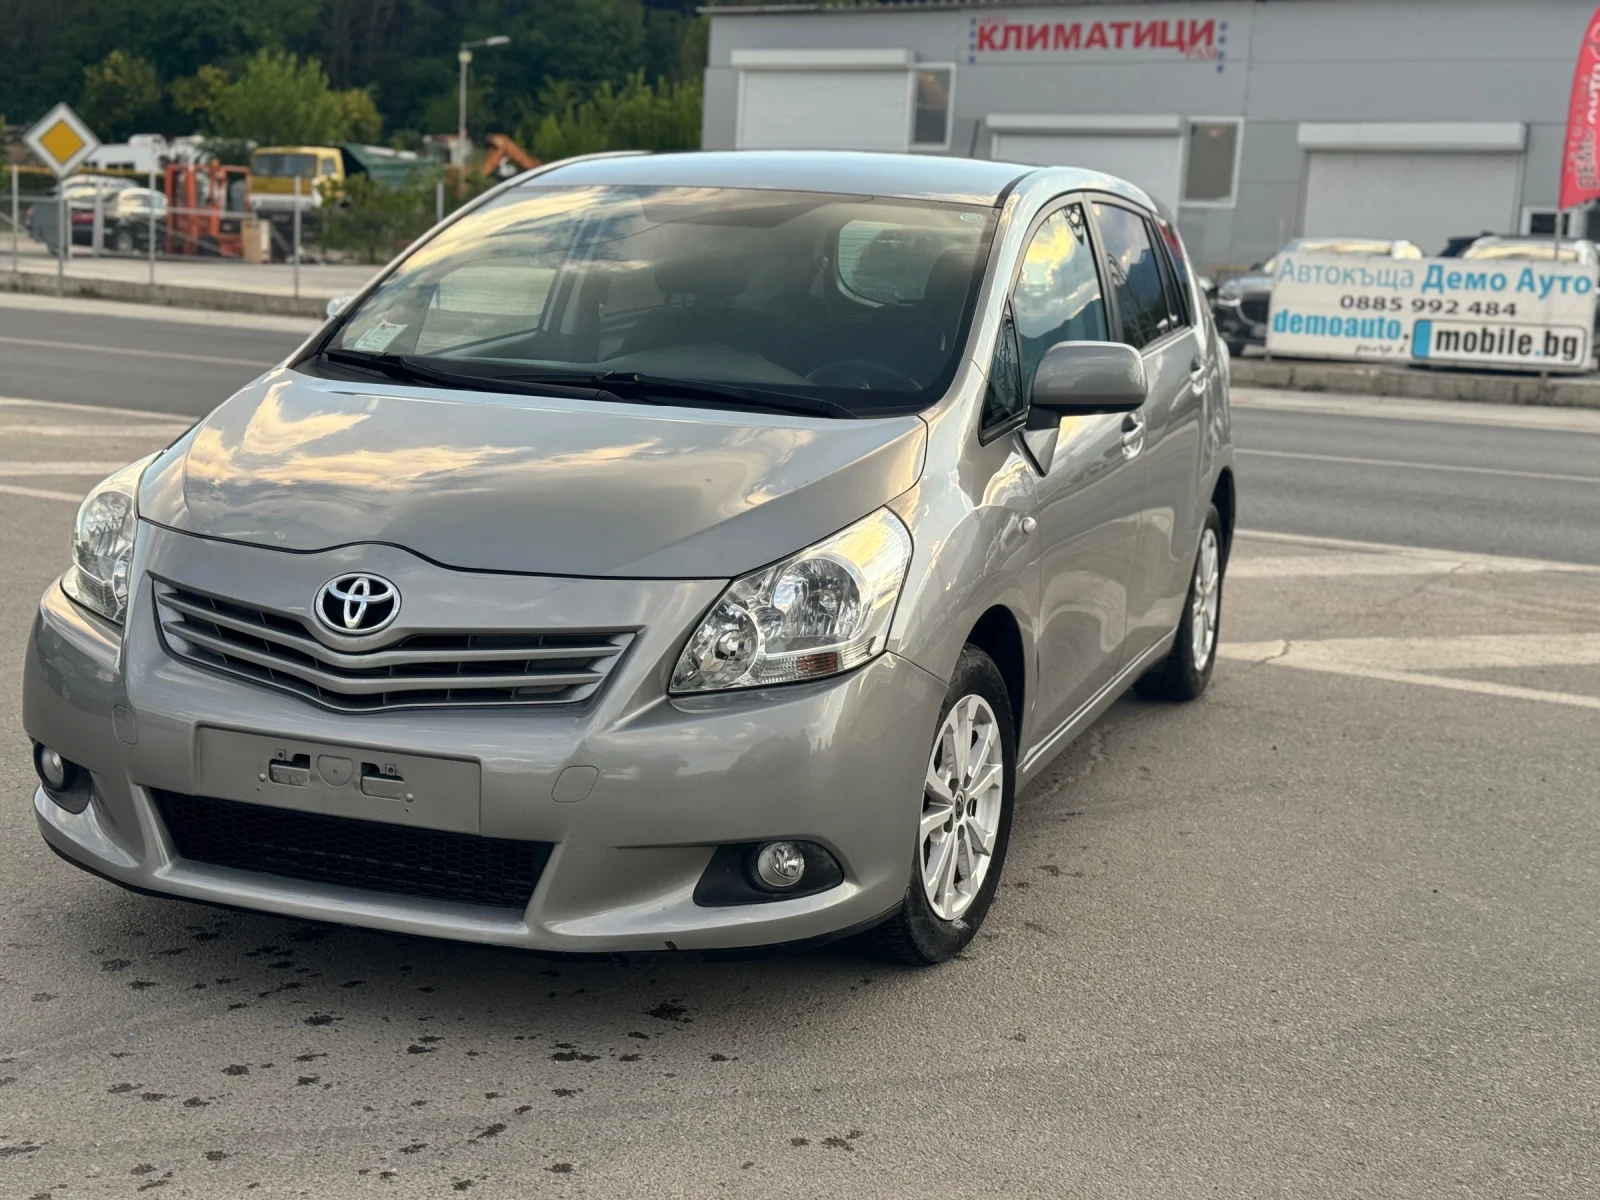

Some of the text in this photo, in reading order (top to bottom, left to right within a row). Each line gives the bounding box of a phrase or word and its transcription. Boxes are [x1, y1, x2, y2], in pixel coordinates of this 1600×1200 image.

[976, 19, 1216, 53] КЛИМАТИЦИ
[1278, 258, 1593, 300] Автокъща Демо Ауто
[1340, 295, 1517, 316] 0885 992 484
[1435, 326, 1579, 362] mobile.bg
